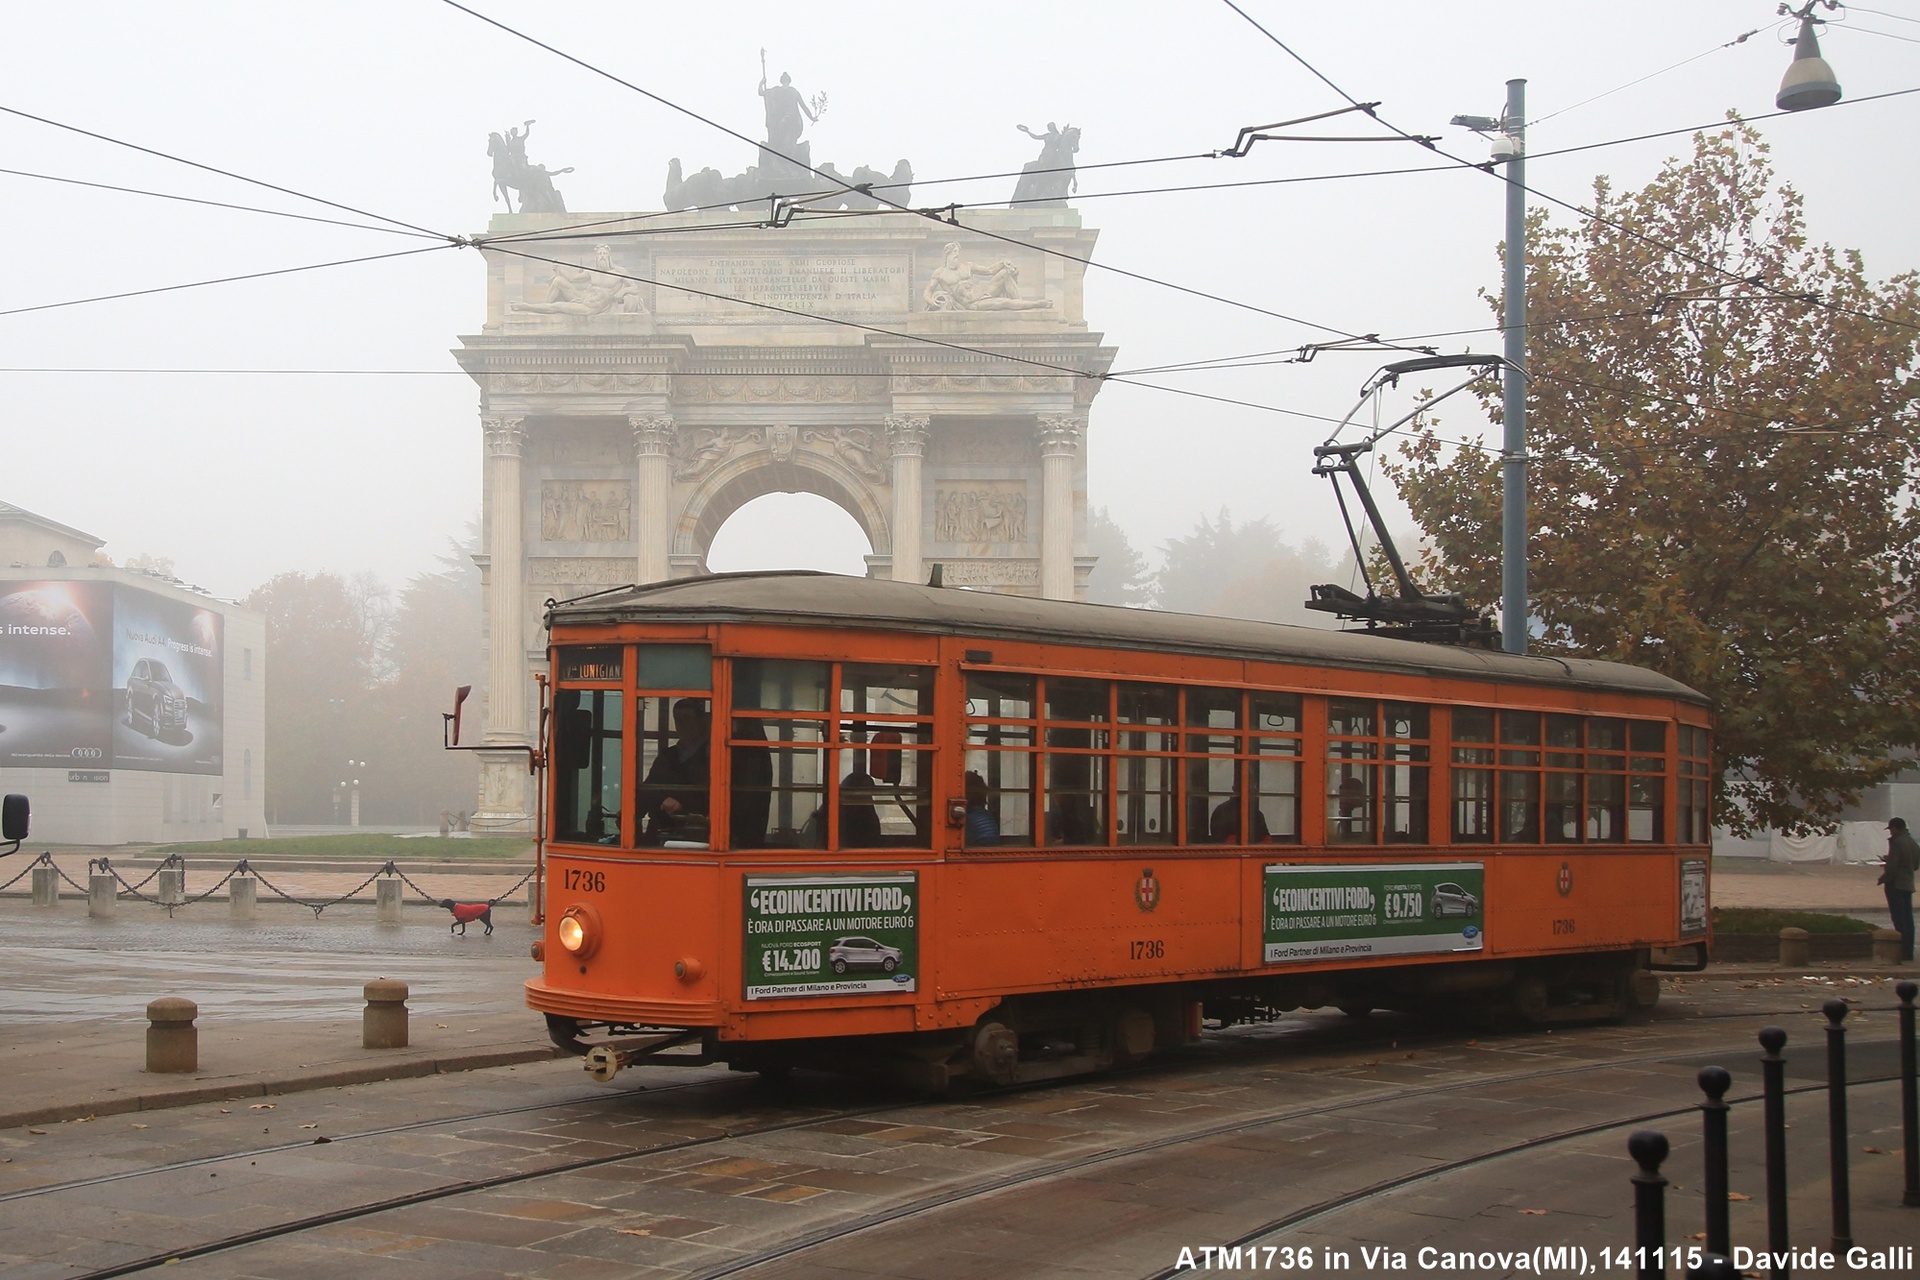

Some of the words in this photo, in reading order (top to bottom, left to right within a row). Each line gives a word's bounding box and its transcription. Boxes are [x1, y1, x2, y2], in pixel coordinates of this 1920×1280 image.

[816, 259, 856, 267] GLORIOSE
[853, 267, 905, 275] LIBERATORI
[8, 624, 71, 636] intense.
[167, 638, 189, 653] Progress
[564, 868, 606, 893] 1736
[748, 919, 753, 934] È
[754, 920, 773, 933] ORA
[775, 920, 784, 932] DI
[785, 918, 824, 932] PASSARE
[825, 918, 832, 931] A
[833, 917, 845, 930] UN
[846, 916, 883, 930] MOTORE
[884, 916, 907, 929] EURO
[908, 915, 914, 928] 6
[1275, 917, 1288, 930] ORA
[1289, 917, 1296, 929] DI
[1296, 916, 1321, 929] PASSARE
[1321, 916, 1326, 928] A
[1326, 916, 1334, 928] UN
[1335, 915, 1357, 928] MOTORE
[1357, 914, 1372, 926] EURO
[1552, 919, 1576, 936] 1736
[1130, 940, 1165, 960] 1736
[1274, 949, 1288, 957] Ford
[1289, 948, 1312, 957] Partner
[1312, 947, 1319, 955] di
[1320, 945, 1340, 954] Milano
[1345, 943, 1372, 953] Provincia
[755, 986, 771, 994] Ford
[772, 985, 798, 993] Partner
[799, 984, 806, 992] di
[806, 983, 830, 991] Milano
[835, 981, 867, 991] Provincia
